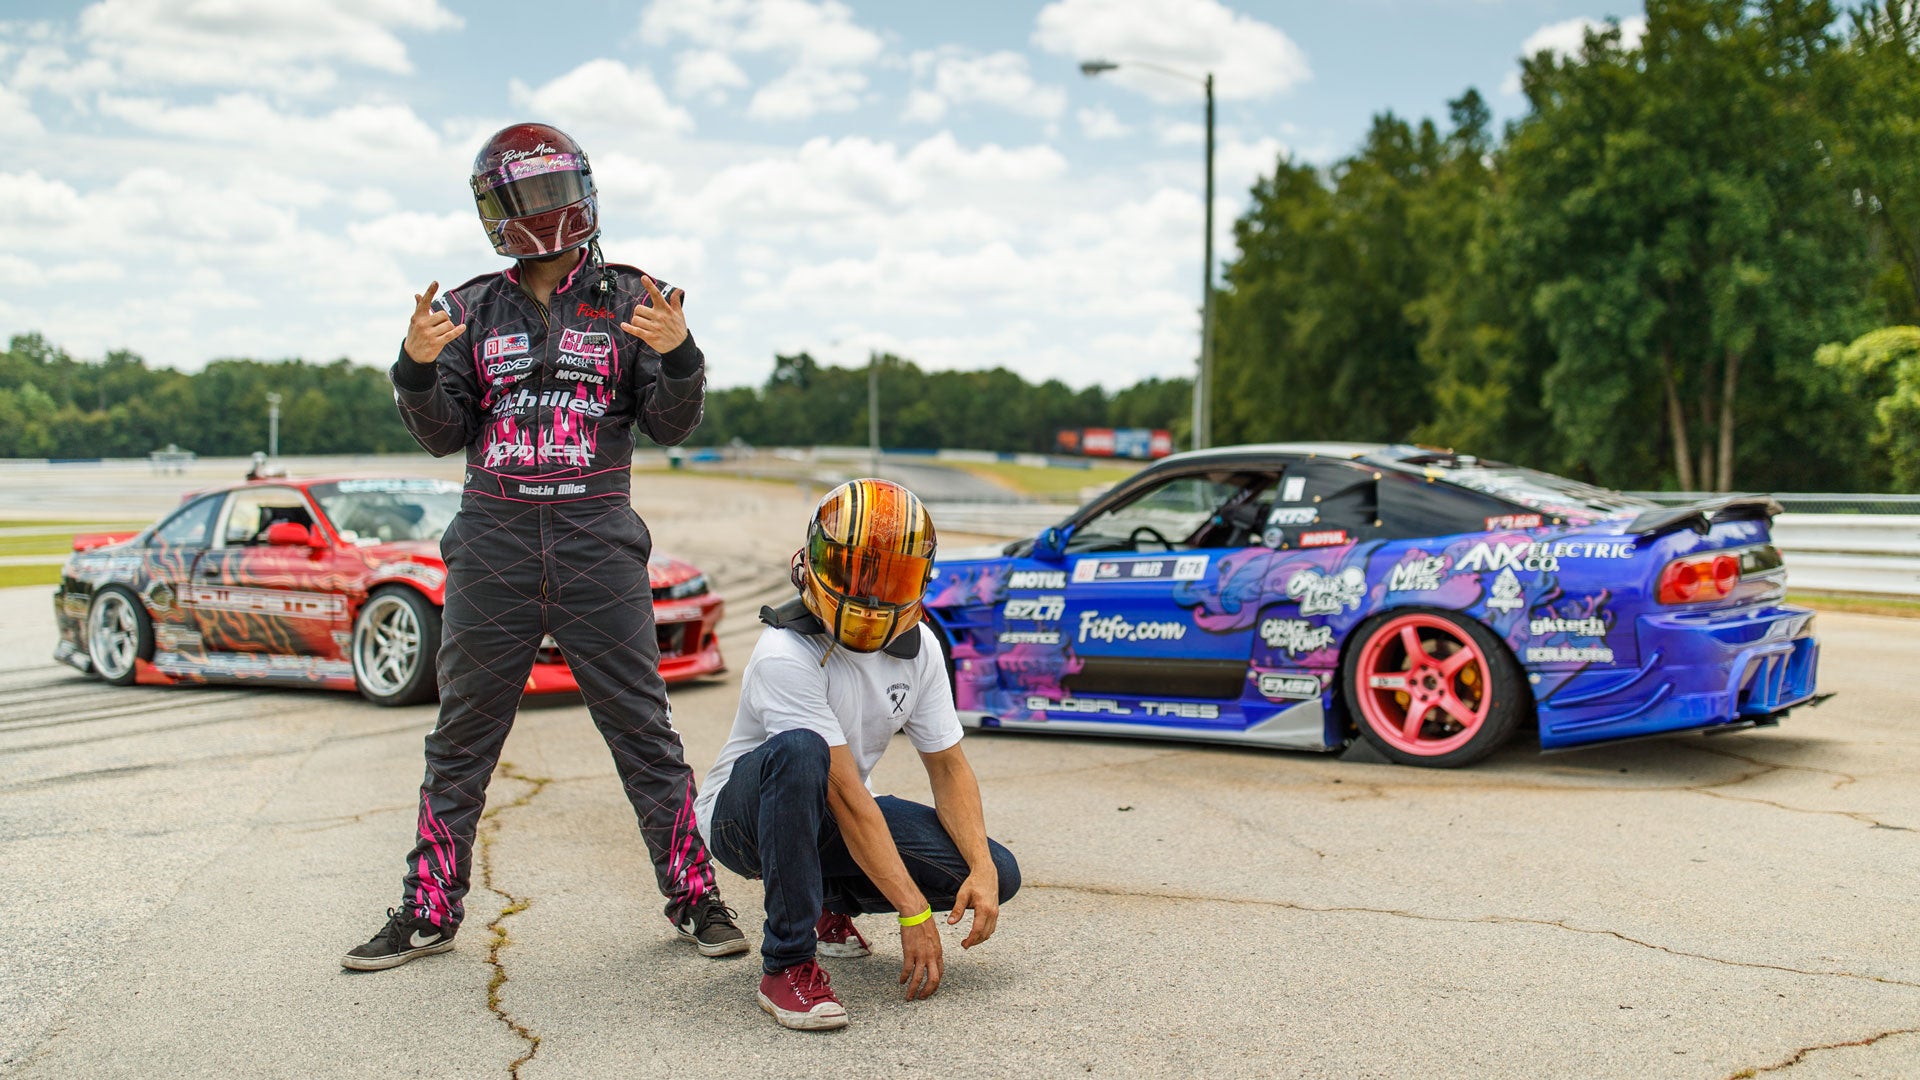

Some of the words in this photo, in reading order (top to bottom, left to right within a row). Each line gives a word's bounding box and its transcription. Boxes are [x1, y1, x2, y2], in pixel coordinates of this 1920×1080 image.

[487, 358, 533, 375] RAYS
[555, 369, 604, 385] MOTUL
[519, 484, 554, 496] Dustin
[558, 483, 586, 495] Miles
[1303, 533, 1342, 546] MOTUL
[1527, 542, 1636, 559] ELECTRIC
[1525, 556, 1560, 572] CO.
[1008, 571, 1066, 589] MOTUL
[1078, 610, 1187, 643] Fitfo.com
[1027, 697, 1131, 715] GLOBAL
[1139, 701, 1219, 719] TIRES
